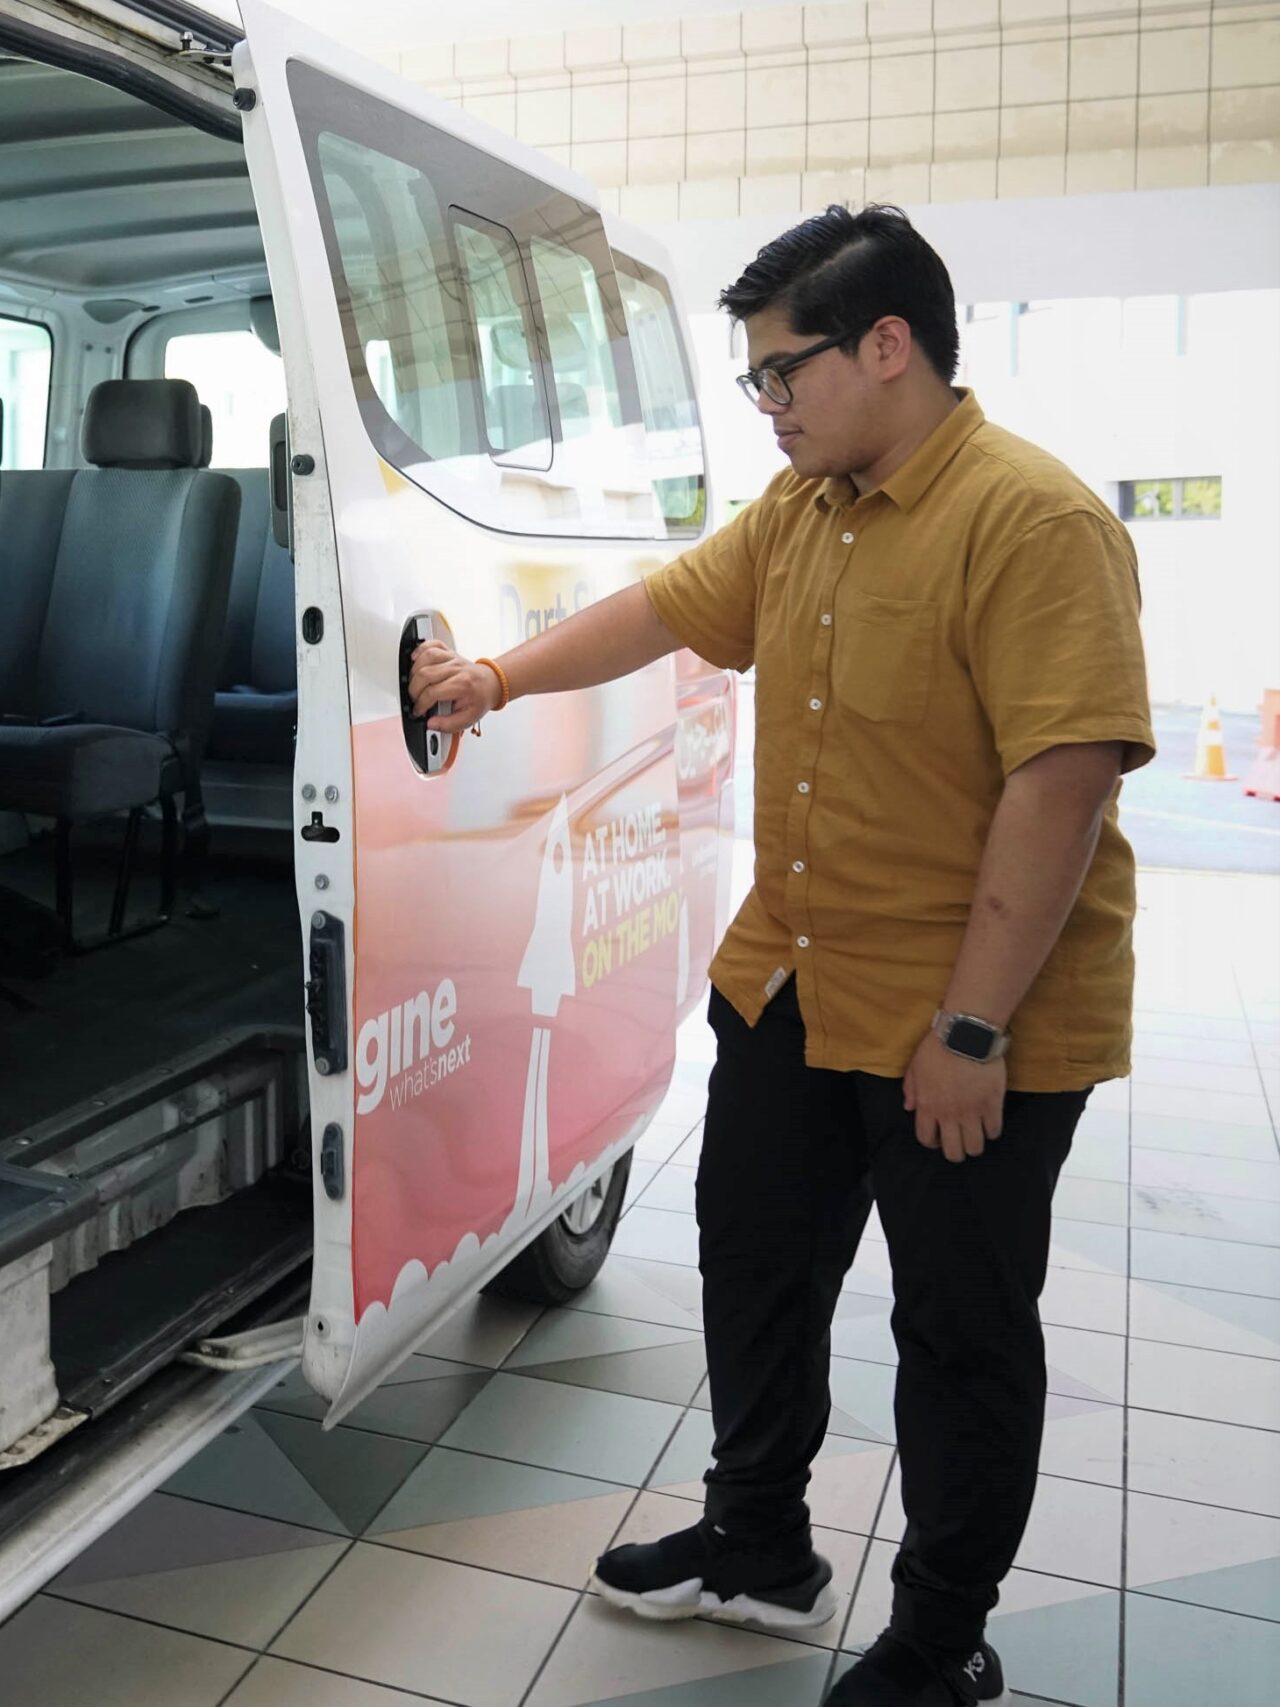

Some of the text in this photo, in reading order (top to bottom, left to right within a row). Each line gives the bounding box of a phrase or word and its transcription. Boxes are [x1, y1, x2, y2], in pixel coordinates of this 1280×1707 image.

[583, 825, 608, 881] AT
[583, 879, 610, 937] AT
[582, 930, 612, 989] ON
[616, 906, 651, 967] THE
